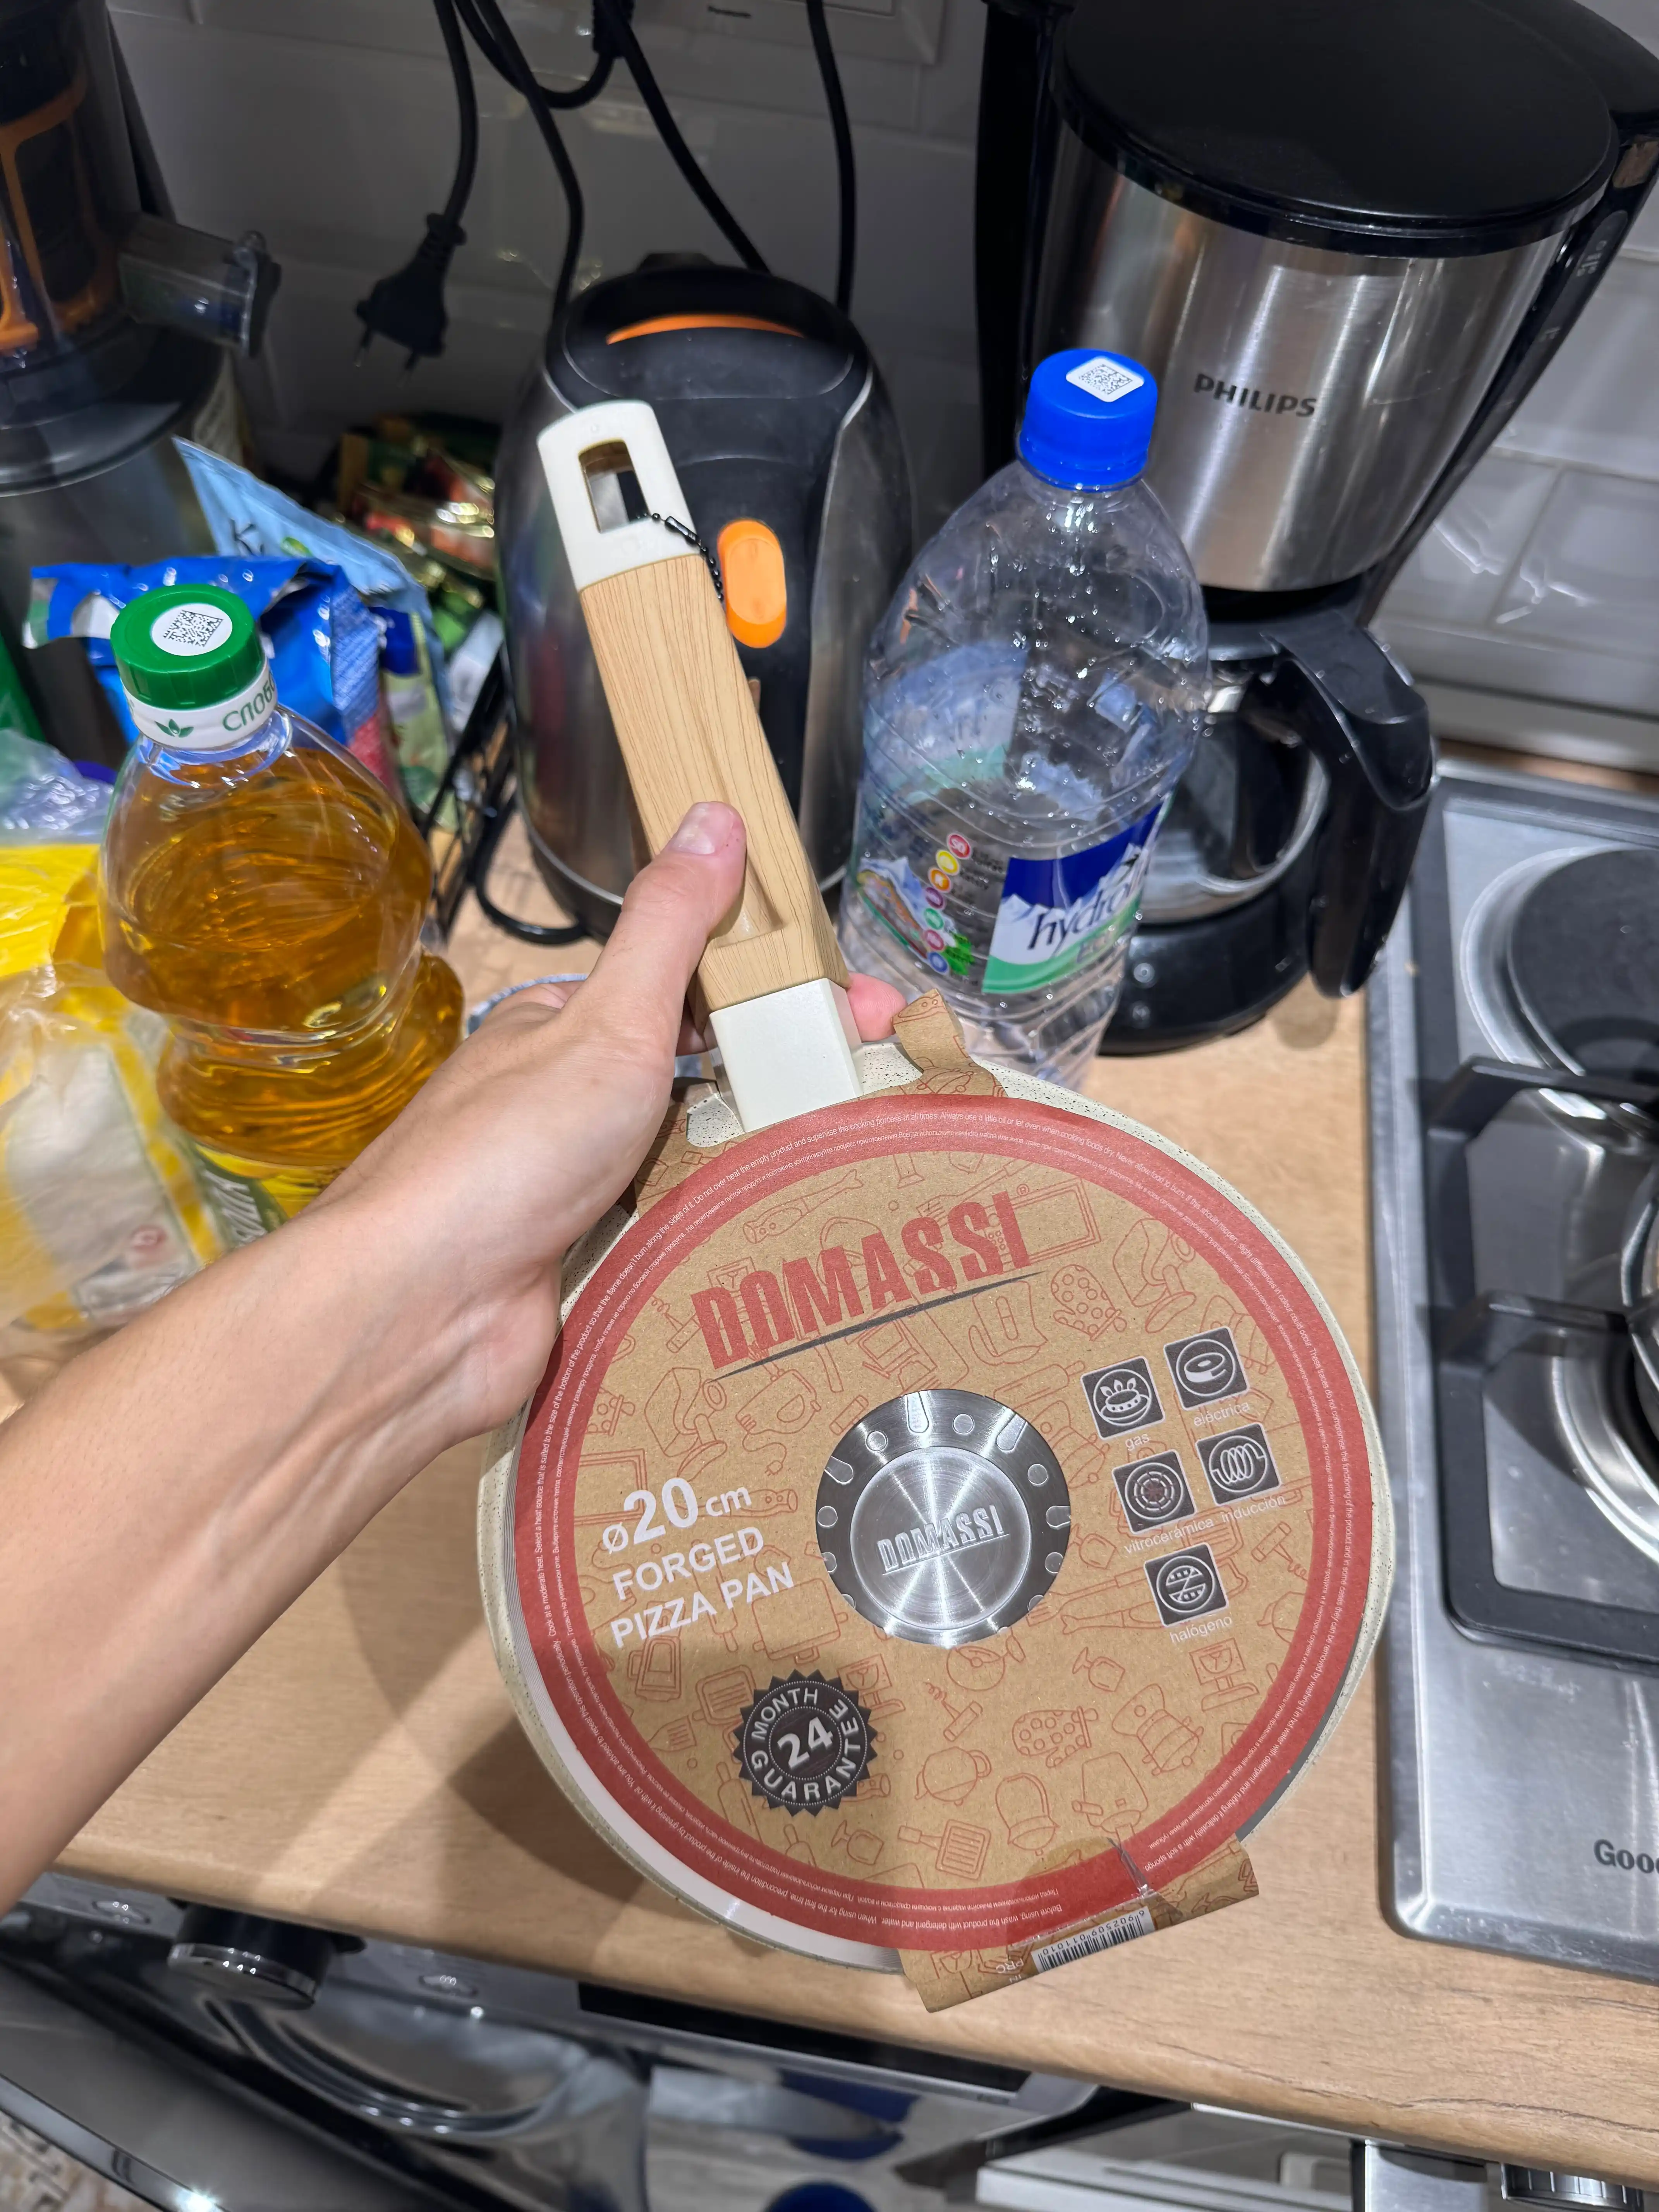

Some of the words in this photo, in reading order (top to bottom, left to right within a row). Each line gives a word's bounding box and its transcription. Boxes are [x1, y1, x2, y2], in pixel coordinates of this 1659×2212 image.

[1194, 373, 1318, 417] PHILIPS
[837, 1124, 849, 1134] the
[849, 1118, 875, 1133] cooking
[793, 1137, 807, 1149] and
[806, 1127, 838, 1146] supervise
[769, 1142, 795, 1161] product
[739, 1163, 751, 1174] the
[749, 1153, 771, 1170] empty
[725, 1168, 741, 1182] heat
[702, 1186, 714, 1198] not
[713, 1178, 728, 1191] over
[741, 1177, 763, 1194] продукт
[693, 1193, 705, 1205] Do
[723, 1188, 743, 1204] пустой
[681, 1204, 691, 1214] of
[692, 1199, 727, 1228] перегревайте
[667, 1209, 685, 1226] sides
[658, 1222, 671, 1235] the
[685, 1223, 695, 1233] Не
[644, 1230, 664, 1250] along
[617, 1257, 639, 1280] doesn't
[648, 1251, 668, 1272] стороне
[606, 1277, 623, 1296] flame
[632, 1267, 652, 1290] боковой
[690, 1191, 1031, 1370] DOMASSI
[628, 1287, 637, 1296] по
[1273, 1286, 1282, 1295] in
[599, 1293, 611, 1306] the
[617, 1294, 633, 1313] горело
[1277, 1293, 1294, 1314] colour
[592, 1303, 605, 1318] that
[612, 1311, 620, 1320] не
[589, 1316, 598, 1326] so
[603, 1318, 616, 1336] пламя
[1288, 1311, 1304, 1330] could
[575, 1324, 595, 1350] product
[592, 1334, 606, 1353] чтобы
[570, 1348, 581, 1360] the
[1307, 1348, 1322, 1369] These
[567, 1358, 576, 1367] of
[558, 1366, 573, 1390] bottom
[1316, 1368, 1330, 1389] traces
[554, 1389, 565, 1401] the
[1324, 1388, 1334, 1399] do
[552, 1400, 561, 1409] of
[1327, 1398, 1337, 1410] not
[548, 1408, 558, 1423] size
[1193, 1401, 1251, 1427] eléctrica
[544, 1423, 555, 1436] the
[1328, 1410, 1347, 1451] compromise
[1125, 1434, 1150, 1451] gas
[539, 1442, 550, 1463] suited
[1340, 1450, 1349, 1462] the
[536, 1471, 546, 1484] that
[1340, 1462, 1353, 1498] functioning
[705, 1485, 752, 1517] cm
[1220, 1494, 1286, 1523] inducción
[1345, 1507, 1353, 1518] the
[876, 1504, 1004, 1573] DOMASSI
[1124, 1516, 1214, 1554] vitrocerámica
[1343, 1519, 1353, 1544] product
[534, 1532, 543, 1553] Select
[1343, 1545, 1352, 1558] and
[535, 1553, 544, 1571] heat.
[612, 1527, 764, 1601] FORGED
[1340, 1566, 1348, 1585] some
[537, 1572, 550, 1604] moderate
[1336, 1586, 1345, 1606] cases
[611, 1592, 716, 1649] PIZZA
[720, 1561, 795, 1610] PAN
[1330, 1606, 1343, 1622] they
[545, 1618, 557, 1637] Cook
[1169, 1614, 1233, 1645] halógeno
[1328, 1621, 1337, 1634] can
[1325, 1634, 1335, 1644] be
[1315, 1643, 1331, 1673] removed
[1309, 1671, 1321, 1681] by
[564, 1674, 585, 1706] operation
[1297, 1679, 1317, 1707] washing
[577, 1704, 589, 1717] this
[751, 1688, 818, 1740] MONTH
[1292, 1710, 1302, 1718] in
[584, 1714, 602, 1736] repeat
[1286, 1716, 1298, 1729] hot
[595, 1735, 605, 1744] to
[777, 1716, 833, 1770] 24
[1276, 1726, 1291, 1745] water
[599, 1741, 620, 1766] advised
[751, 1698, 861, 1801] GUARANTEE
[1267, 1743, 1281, 1758] with
[616, 1763, 628, 1775] are
[623, 1773, 636, 1787] You
[1238, 1780, 1252, 1795] and
[639, 1791, 654, 1806] with
[649, 1802, 658, 1810] it
[1219, 1790, 1243, 1814] rubbing
[653, 1804, 680, 1831] greasing
[1216, 1809, 1224, 1817] it
[675, 1824, 687, 1837] by
[1192, 1812, 1221, 1839] delicately
[683, 1830, 708, 1853] product
[1181, 1834, 1196, 1848] with
[704, 1848, 716, 1859] the
[713, 1854, 723, 1864] of
[1165, 1846, 1179, 1859] soft
[1594, 1839, 1659, 1874] Goo
[721, 1858, 741, 1875] inside
[738, 1869, 751, 1881] the
[749, 1873, 789, 1898] precondition
[803, 1898, 817, 1909] first
[816, 1902, 828, 1913] the
[828, 1906, 838, 1915] for
[838, 1906, 857, 1920] using
[857, 1913, 877, 1924] When
[1000, 1915, 1018, 1925] wash
[901, 1920, 914, 1929] and
[948, 1922, 962, 1930] with
[962, 1917, 988, 1929] product
[989, 1918, 1000, 1927] the
[1092, 1915, 1134, 1936] 902509
[1042, 1934, 1086, 1955] 011010
[996, 1958, 1024, 1974] PRC
